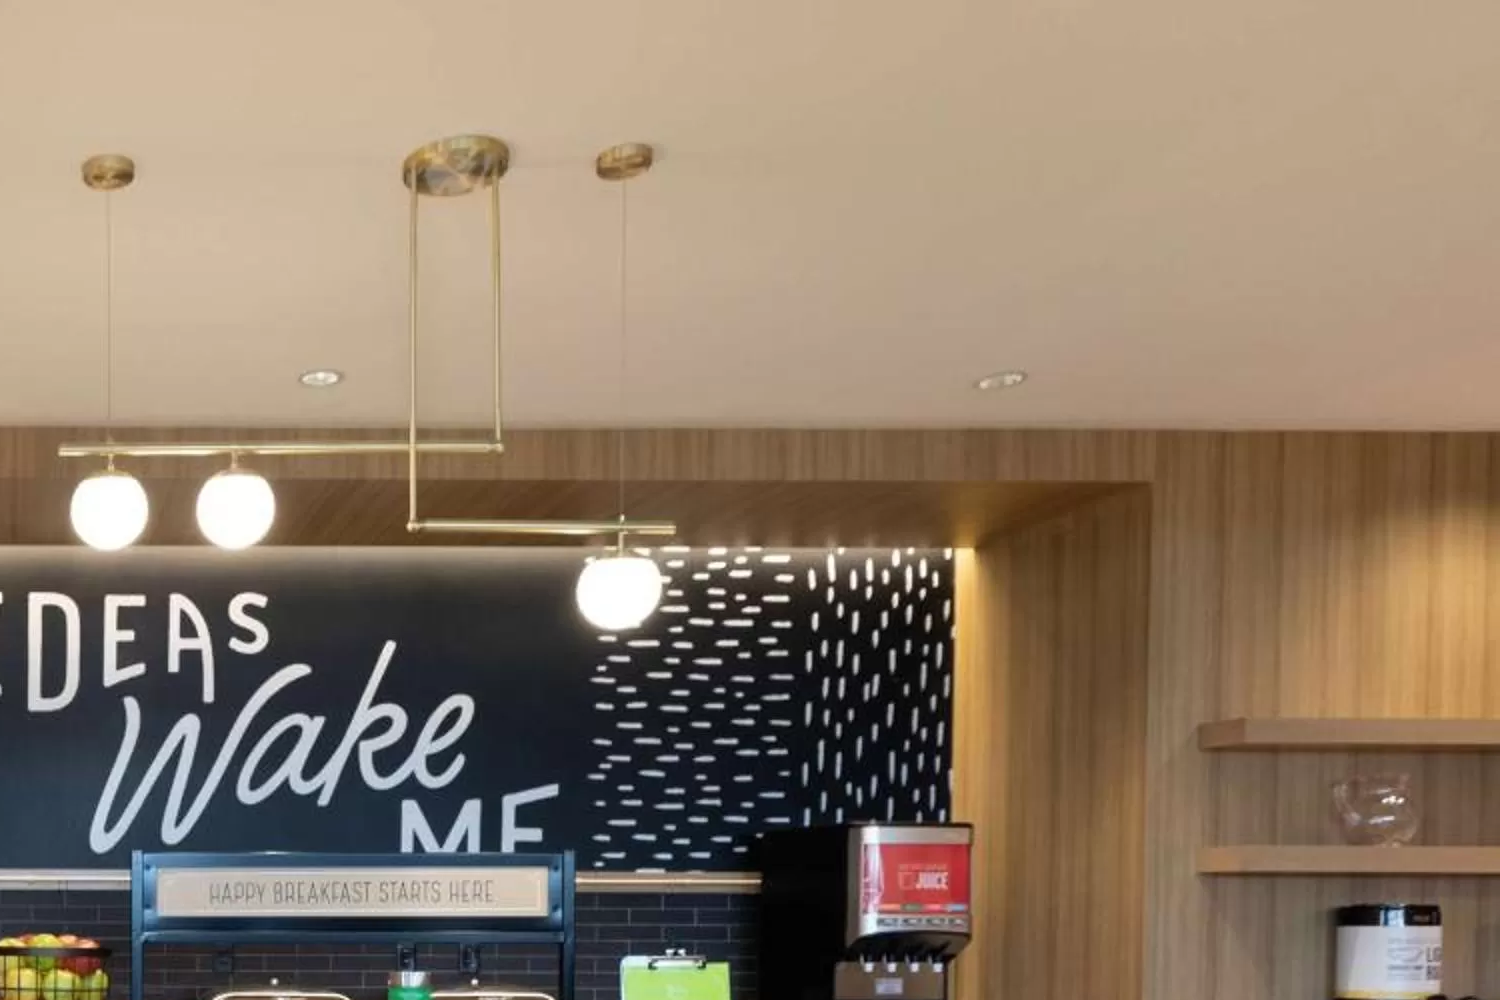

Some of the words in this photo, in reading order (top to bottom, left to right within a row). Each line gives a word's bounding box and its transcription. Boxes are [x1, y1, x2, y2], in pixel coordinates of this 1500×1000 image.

[88, 640, 476, 854] Wake
[208, 881, 266, 905] HAPPY
[272, 881, 372, 905] BREAKFAST
[378, 880, 442, 904] STARTS
[448, 879, 495, 903] HERE
